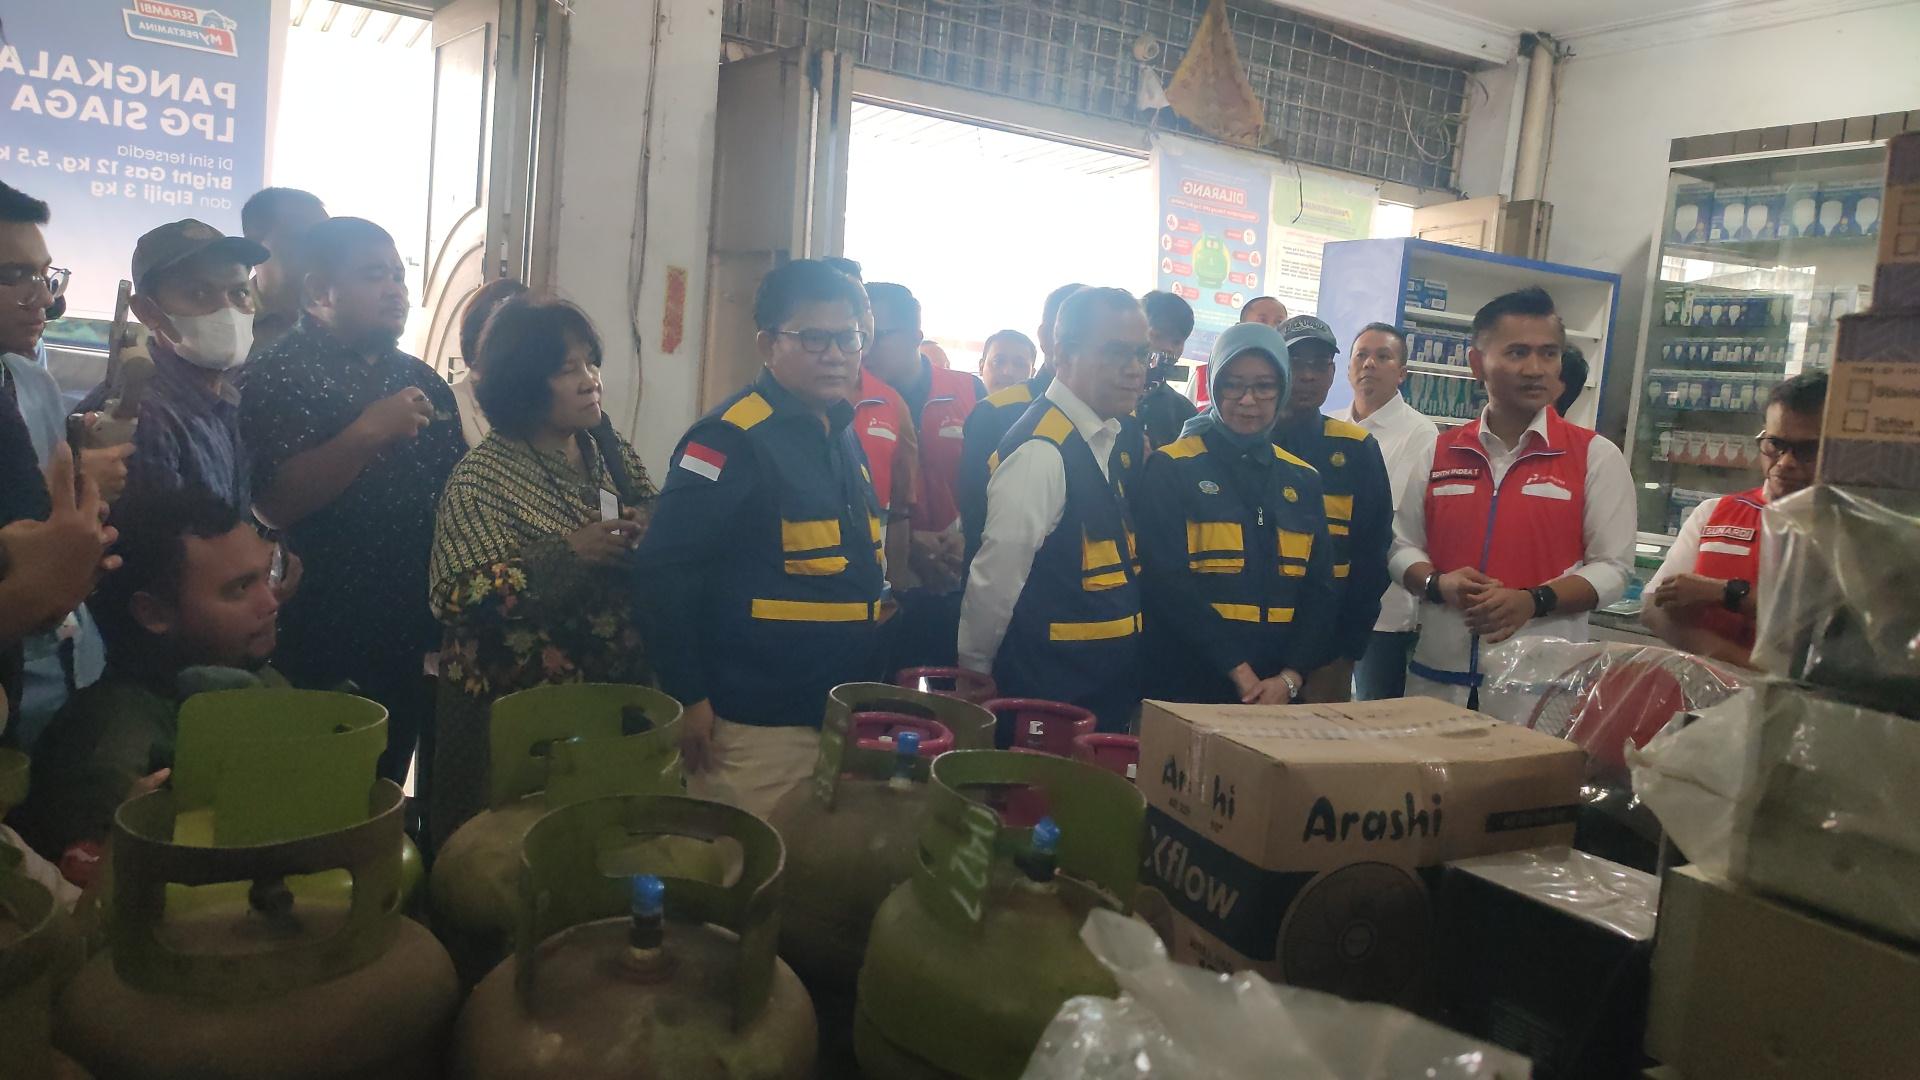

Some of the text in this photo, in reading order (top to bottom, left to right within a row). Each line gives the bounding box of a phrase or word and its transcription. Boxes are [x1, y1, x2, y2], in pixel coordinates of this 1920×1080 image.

[1705, 526, 1751, 538] SUNARDI
[1162, 754, 1235, 821] Arhi
[1302, 791, 1443, 843] Arashi
